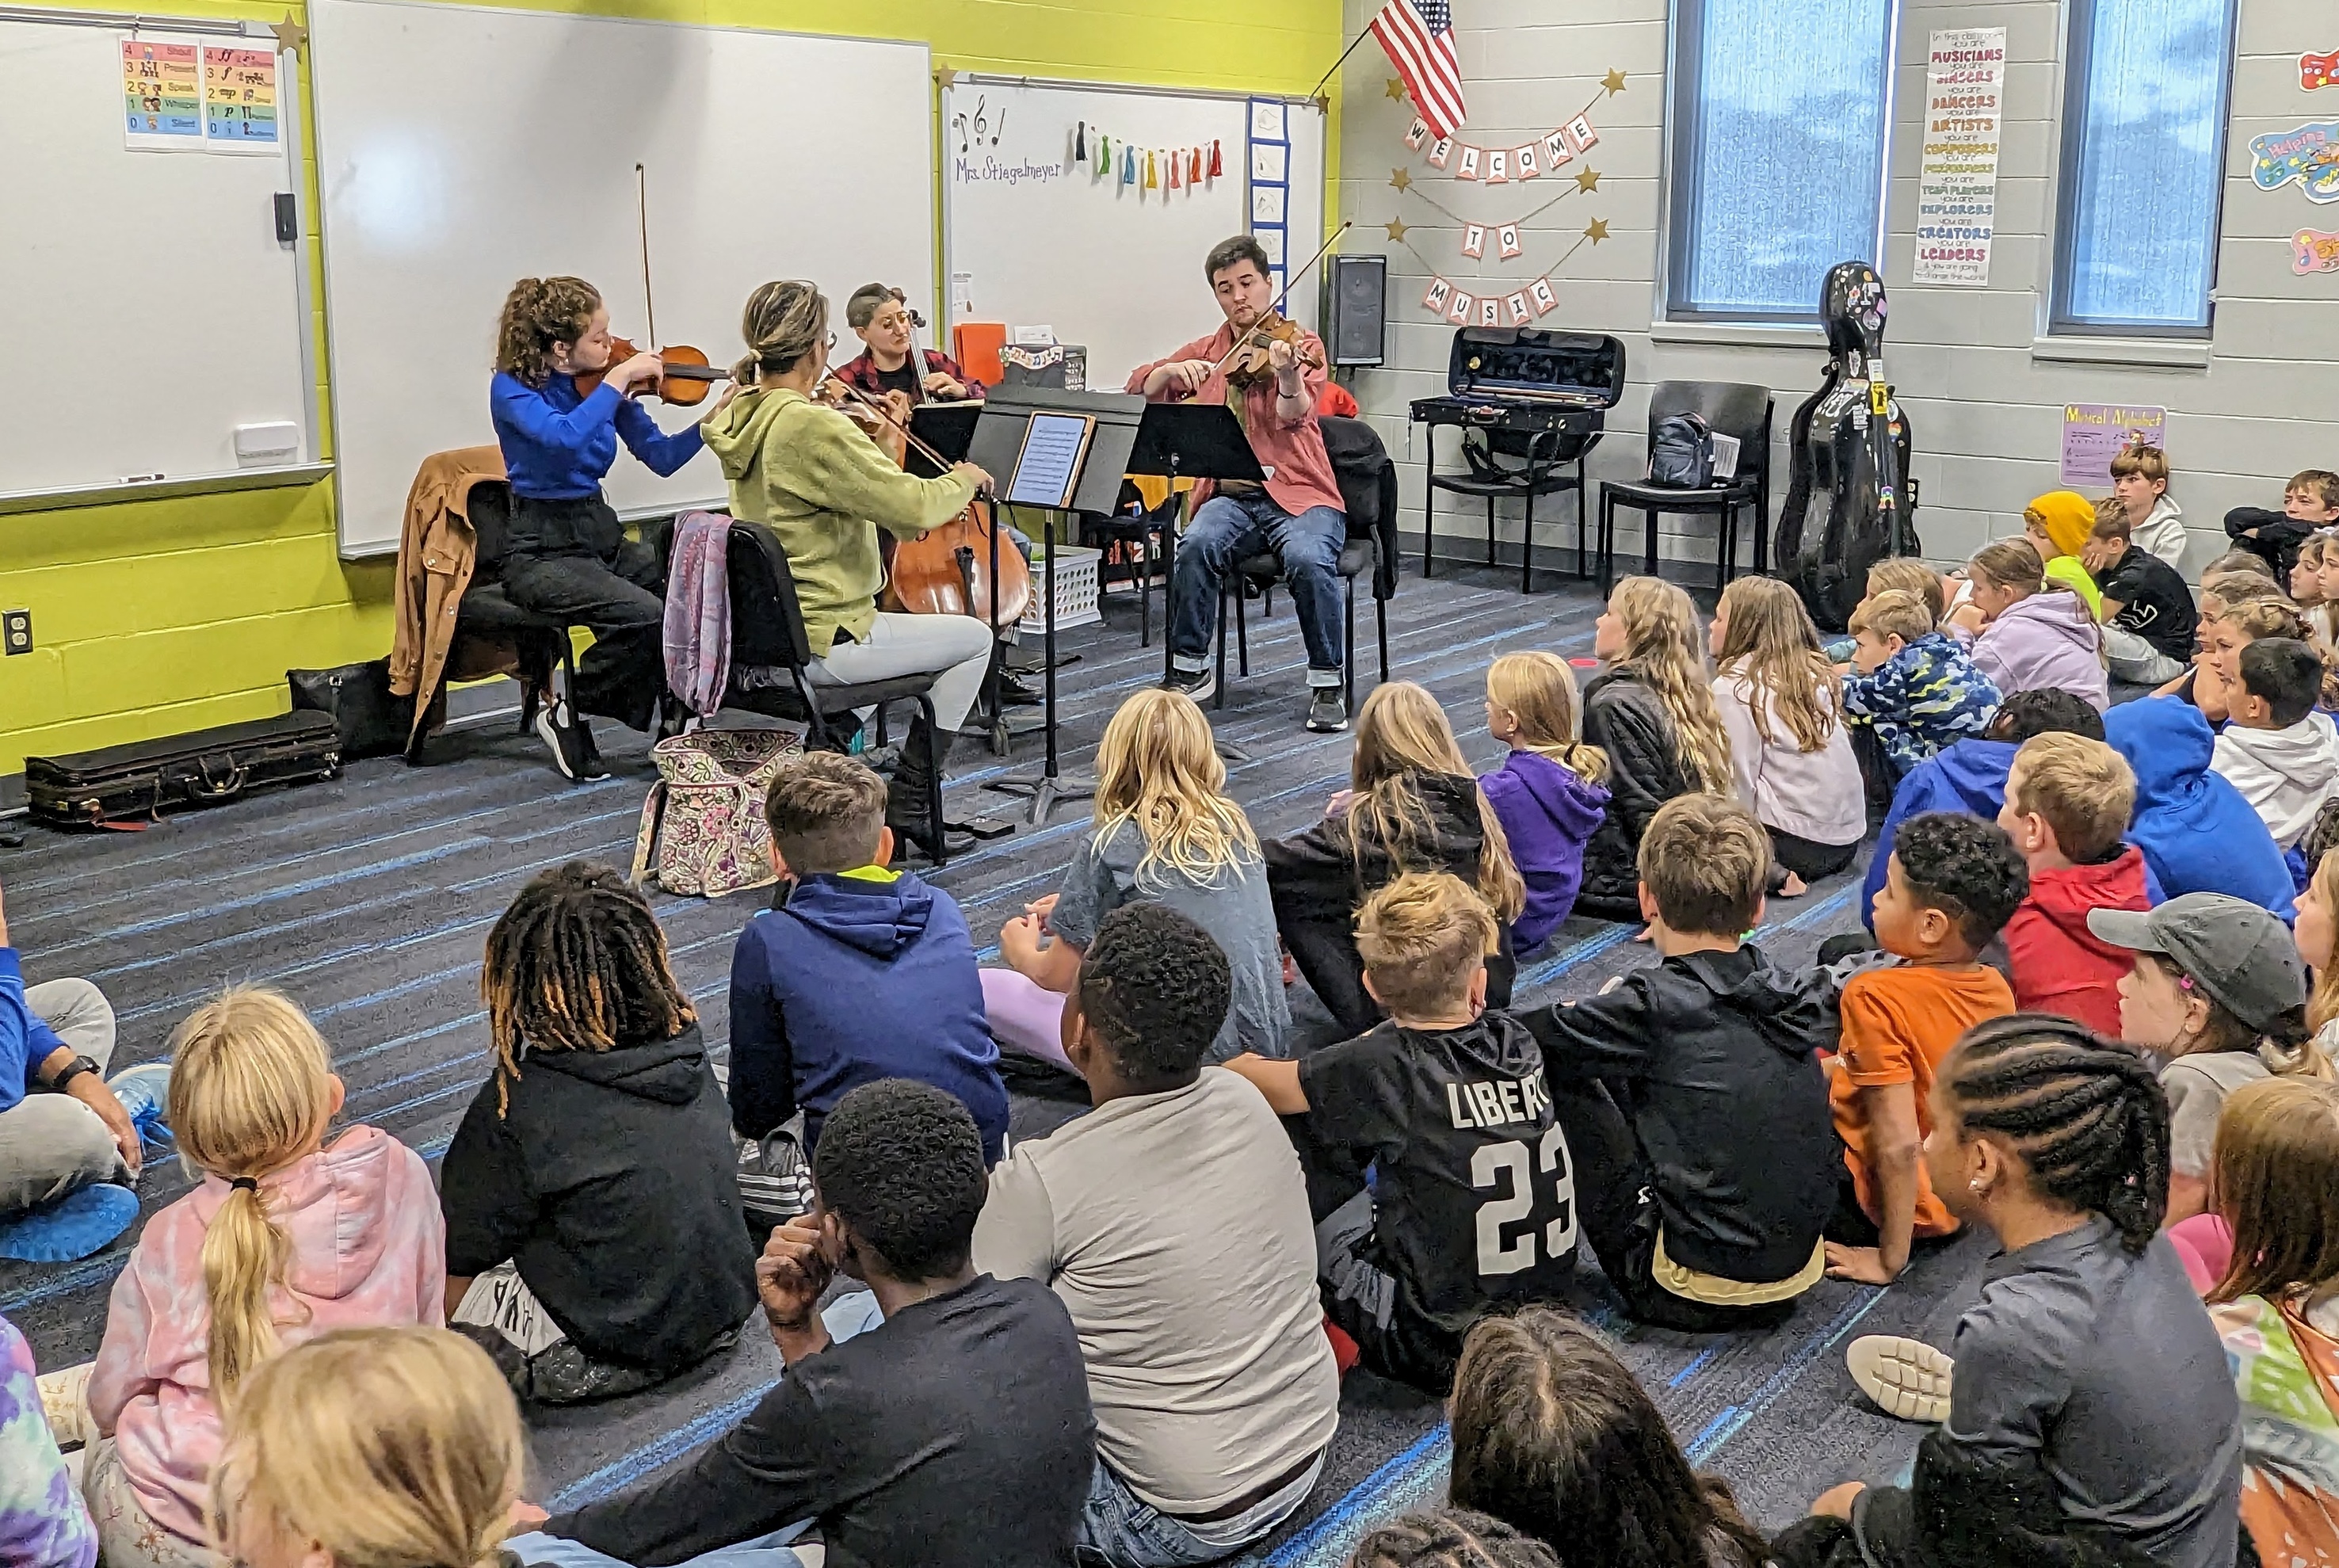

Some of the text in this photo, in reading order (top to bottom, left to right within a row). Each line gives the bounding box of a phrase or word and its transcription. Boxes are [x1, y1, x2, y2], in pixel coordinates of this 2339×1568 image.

[1932, 48, 2004, 63] MUSICIANS
[126, 62, 134, 73] 3
[208, 67, 214, 78] 3
[128, 81, 135, 92] 2
[208, 88, 215, 99] 2
[1932, 94, 1996, 110] DANCERS
[130, 117, 138, 128] 0
[210, 123, 217, 133] 0
[1932, 118, 1994, 133] ARTISTS
[1410, 122, 1587, 171] WELCOME
[983, 155, 1061, 185] Stiegelmeyer
[1941, 177, 1958, 185] you
[1920, 204, 1994, 216] EXPLORERS
[1939, 219, 1956, 227] you
[1470, 231, 1515, 246] TO
[1917, 227, 1992, 240] CREATORS
[1920, 247, 1986, 262] LEADERS
[1430, 284, 1549, 319] MUSIC
[2066, 406, 2163, 430] Musical Alphabet
[1470, 1120, 1578, 1276] 23
